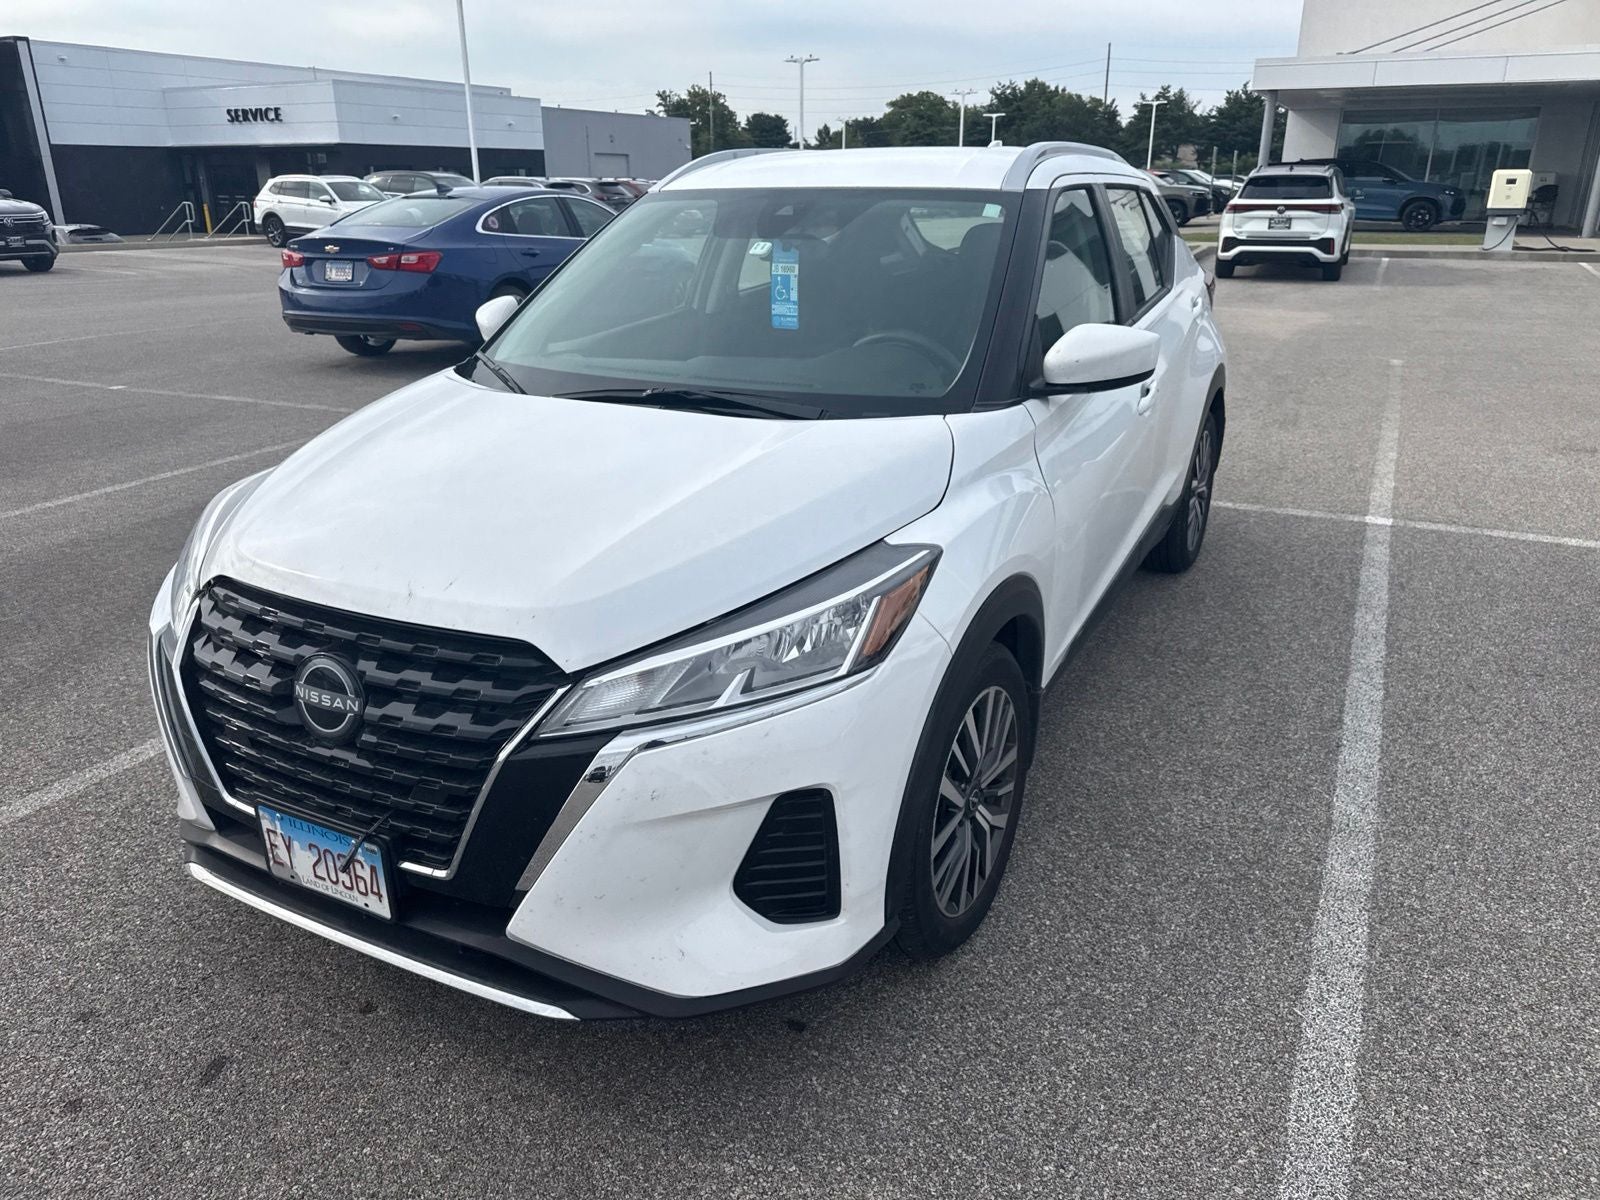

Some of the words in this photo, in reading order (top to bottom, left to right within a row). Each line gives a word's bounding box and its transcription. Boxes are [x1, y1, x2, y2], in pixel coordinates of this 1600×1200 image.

[226, 107, 283, 123] SERVICE
[296, 684, 359, 711] NISSAN
[288, 817, 350, 846] ILLINOIS
[266, 828, 294, 870] EY
[302, 875, 320, 889] LAND
[331, 885, 359, 903] LINCOLN
